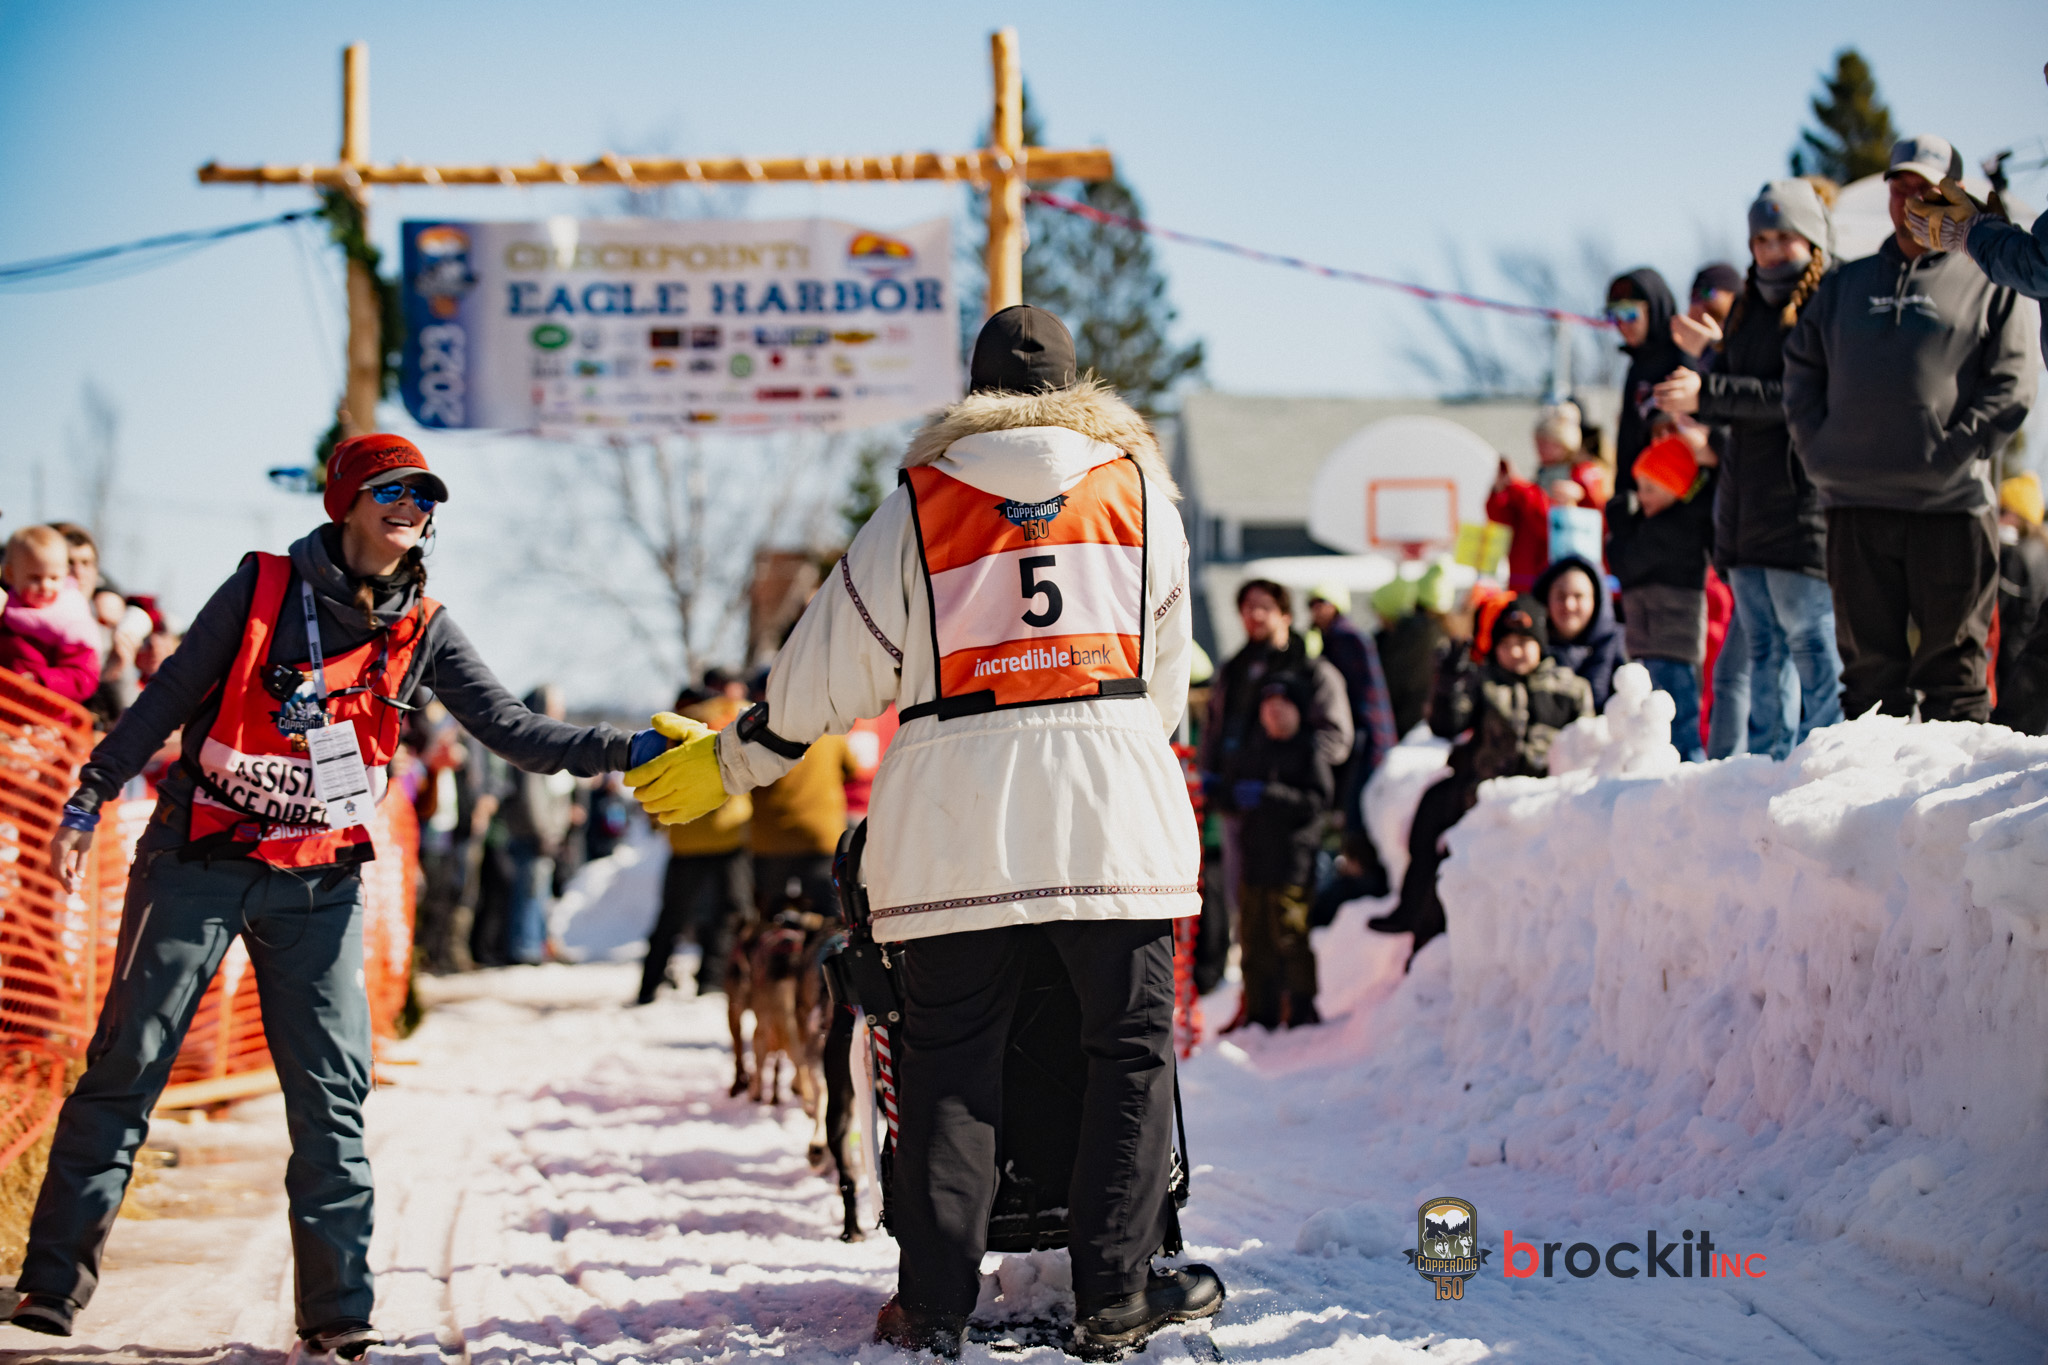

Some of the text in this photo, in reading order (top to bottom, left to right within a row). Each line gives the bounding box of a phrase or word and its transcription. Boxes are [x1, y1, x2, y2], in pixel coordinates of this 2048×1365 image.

[507, 277, 943, 316] EAGLE HARBOR
[419, 323, 466, 426] 2023
[1006, 502, 1059, 519] COPPERDOG
[1021, 518, 1049, 541] 150
[1019, 554, 1063, 628] 5
[278, 716, 325, 732] COPPERDO
[235, 761, 316, 798] ASSIST
[264, 799, 328, 824] DIRE
[257, 822, 334, 842] alume
